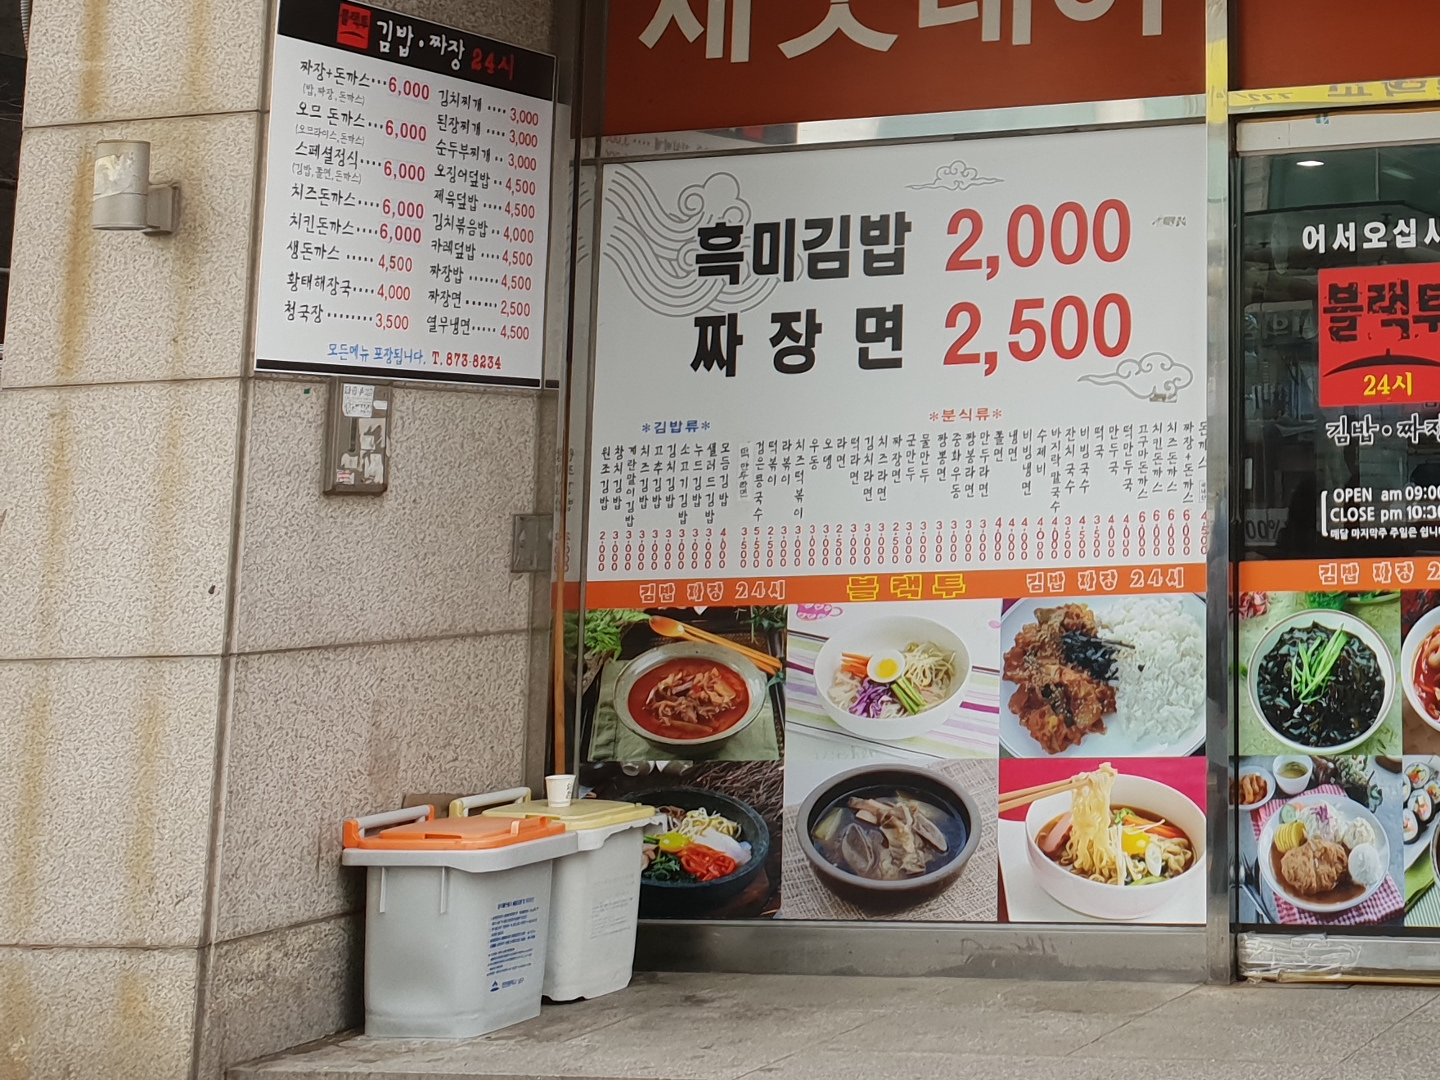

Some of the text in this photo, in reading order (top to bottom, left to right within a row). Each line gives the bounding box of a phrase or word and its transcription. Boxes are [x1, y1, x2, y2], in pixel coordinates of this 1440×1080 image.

[388, 76, 430, 100] 6,000
[438, 89, 539, 126] 김치찌개 3,000
[327, 108, 365, 128] 돈까스
[385, 120, 427, 142] 6,000
[437, 114, 538, 148] 된장찌개 3,000
[435, 138, 537, 171] 순두부찌개 3,000
[384, 160, 426, 182] 6,000
[434, 163, 536, 196] 오징어덮밥 4,500
[291, 183, 424, 219] 치즈돈까스 6,000
[434, 189, 535, 219] 제육덮밥 4,500
[289, 212, 421, 244] 치킨돈까스 6,000
[503, 226, 534, 244] 4,000
[695, 198, 1132, 285] 흑미김밥 2,000
[286, 239, 413, 272] 생돈까스 4,500
[502, 249, 533, 267] 4,500
[286, 271, 411, 301] 황태해장국 4,000
[429, 263, 532, 291] 짜장밥 4,500
[284, 300, 410, 330] 청국장 3,500
[428, 288, 531, 317] 짜장면 2,500
[426, 314, 530, 341] 열무냉면 4,500
[942, 292, 1133, 378] 2,500
[1363, 372, 1414, 397] 24시
[1333, 487, 1373, 503] OPEN
[1381, 488, 1402, 501] am
[1330, 506, 1375, 522] CLOSE
[1381, 509, 1402, 523] pm
[735, 579, 786, 600] 24시
[1129, 567, 1184, 589] 24시
